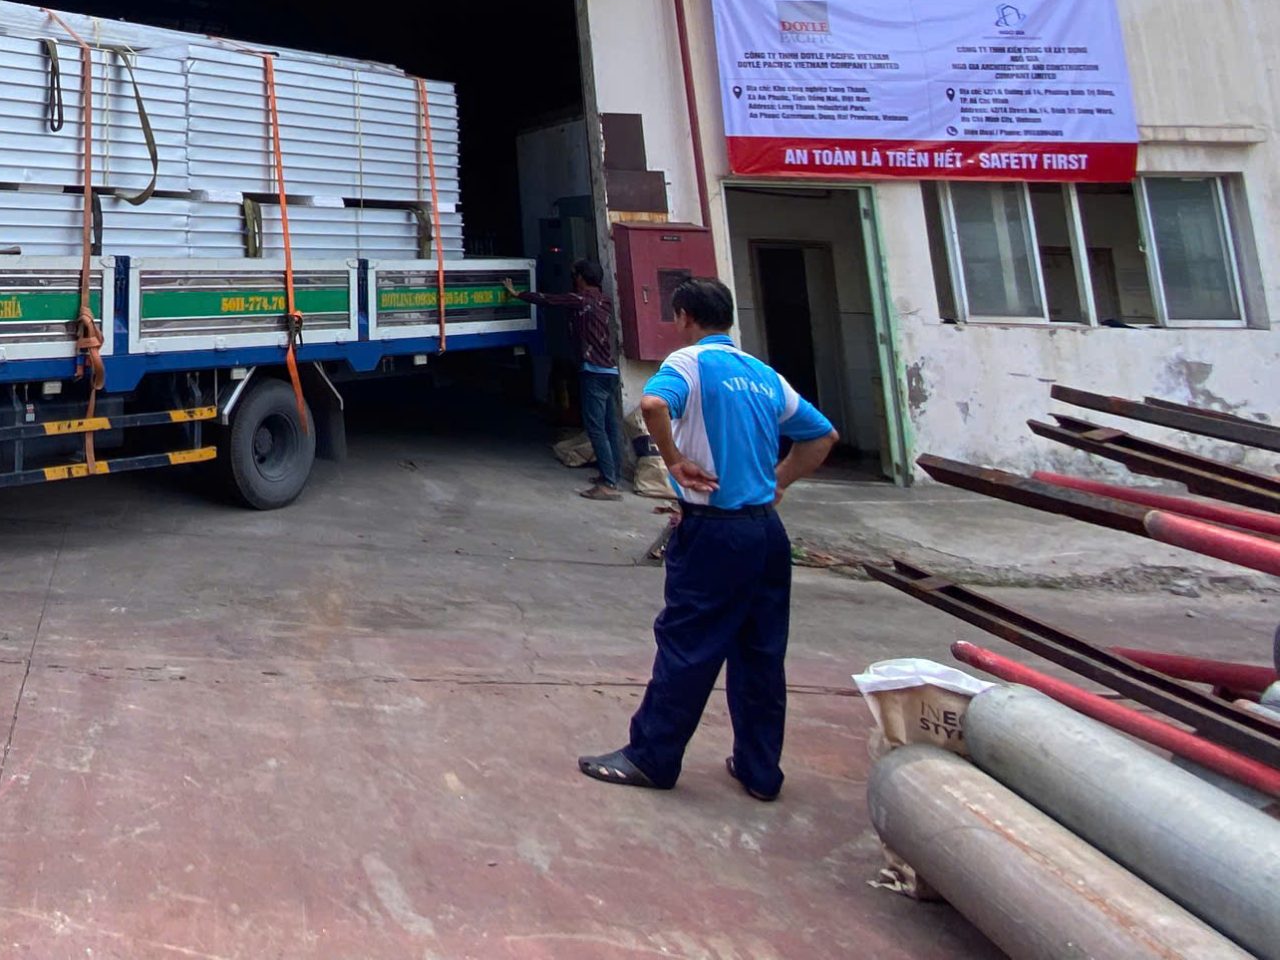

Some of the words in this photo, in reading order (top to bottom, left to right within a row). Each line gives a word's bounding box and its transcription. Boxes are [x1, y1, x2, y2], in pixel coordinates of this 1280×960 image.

[780, 20, 828, 32] DOYLE
[800, 52, 824, 60] DOYLE
[785, 149, 808, 165] AN
[812, 146, 857, 166] TOÀN
[862, 148, 882, 166] LÀ
[886, 148, 928, 167] TRÊN
[934, 147, 962, 168] HẾT
[980, 153, 1038, 170] SAFETY
[1043, 154, 1087, 170] FIRST
